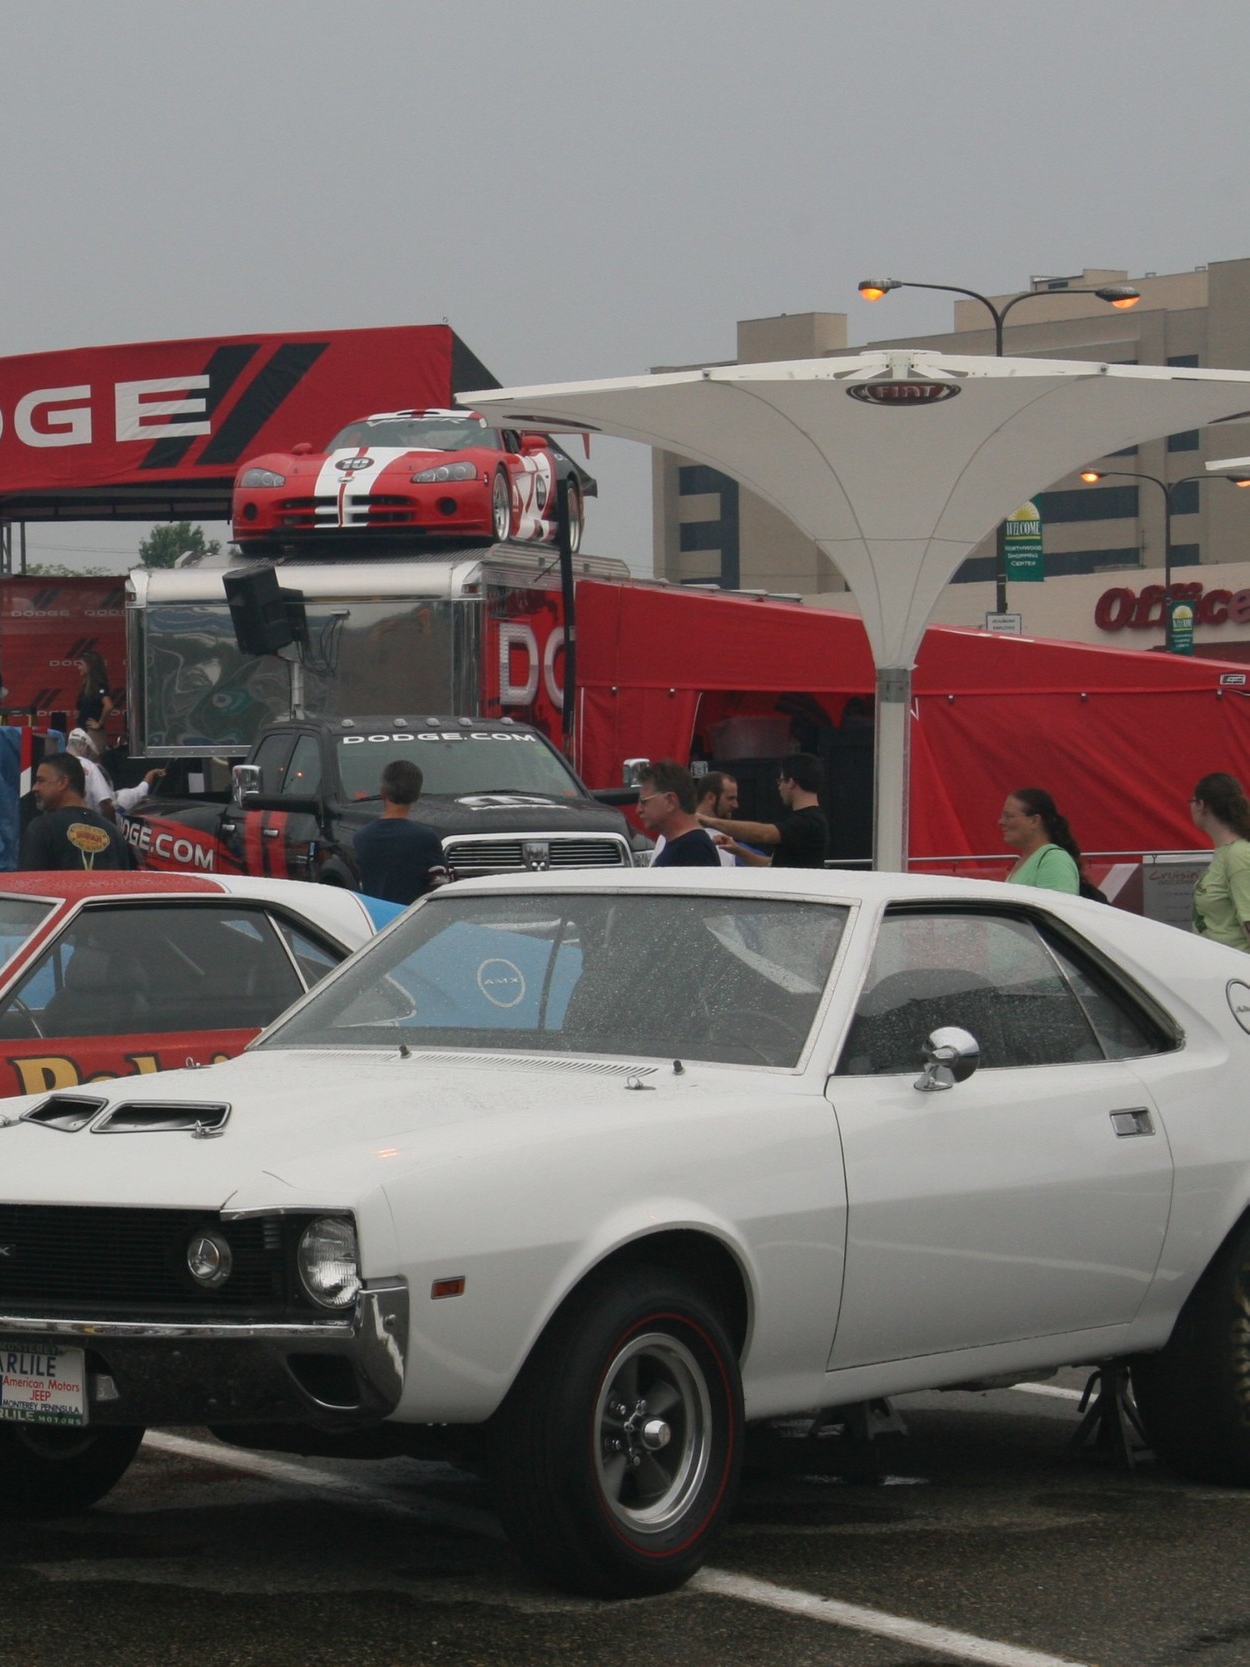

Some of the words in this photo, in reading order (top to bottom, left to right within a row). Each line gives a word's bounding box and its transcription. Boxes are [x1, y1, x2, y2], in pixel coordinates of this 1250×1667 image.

[876, 385, 935, 398] FIAT
[1006, 521, 1041, 535] WELCOME
[11, 609, 71, 617] DODGE
[343, 732, 537, 745] DODGE.COM
[2, 1374, 45, 1390] American
[47, 1380, 80, 1393] Motors
[29, 1389, 52, 1401] JEEP
[2, 1399, 39, 1411] MONTEREY
[40, 1402, 80, 1414] PENINSULA
[38, 1416, 82, 1426] MOTORS
